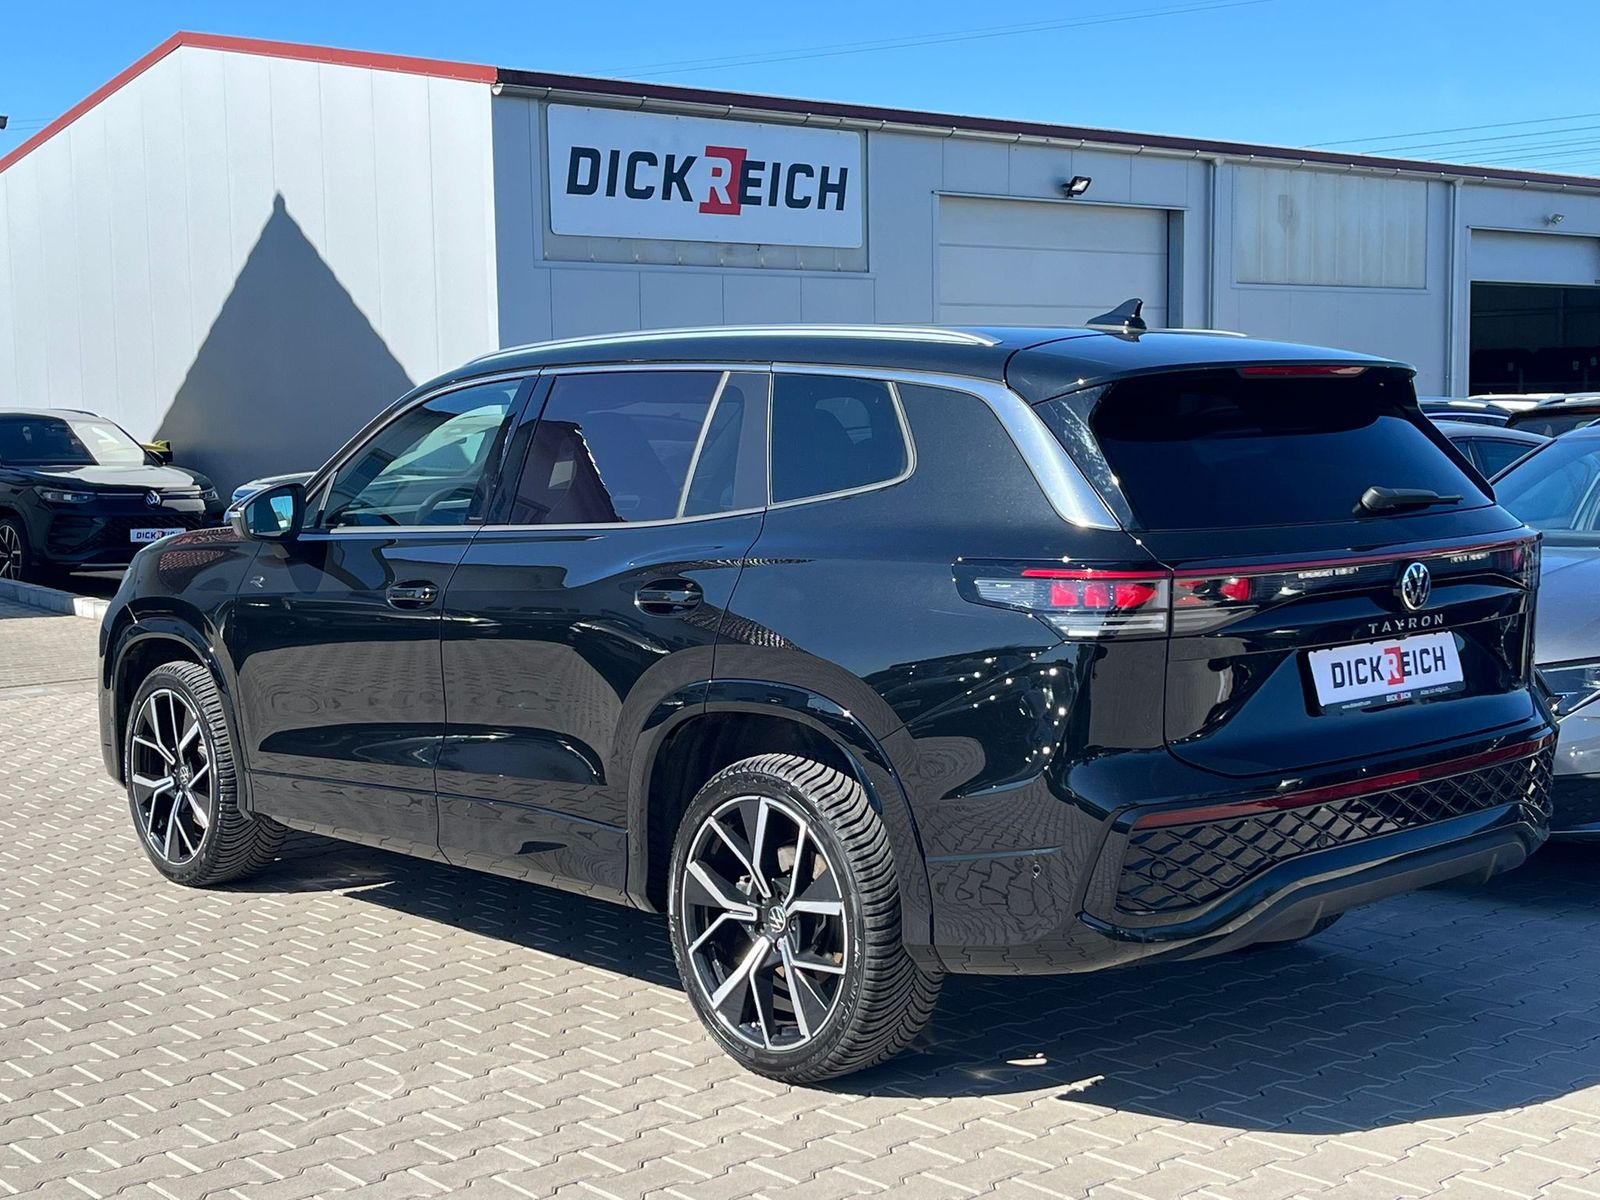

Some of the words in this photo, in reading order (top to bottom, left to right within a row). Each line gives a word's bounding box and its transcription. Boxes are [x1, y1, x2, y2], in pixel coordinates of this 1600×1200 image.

[566, 146, 849, 212] DICKREICH
[1368, 613, 1443, 634] TAYRON
[1330, 645, 1447, 689] DICKREICH
